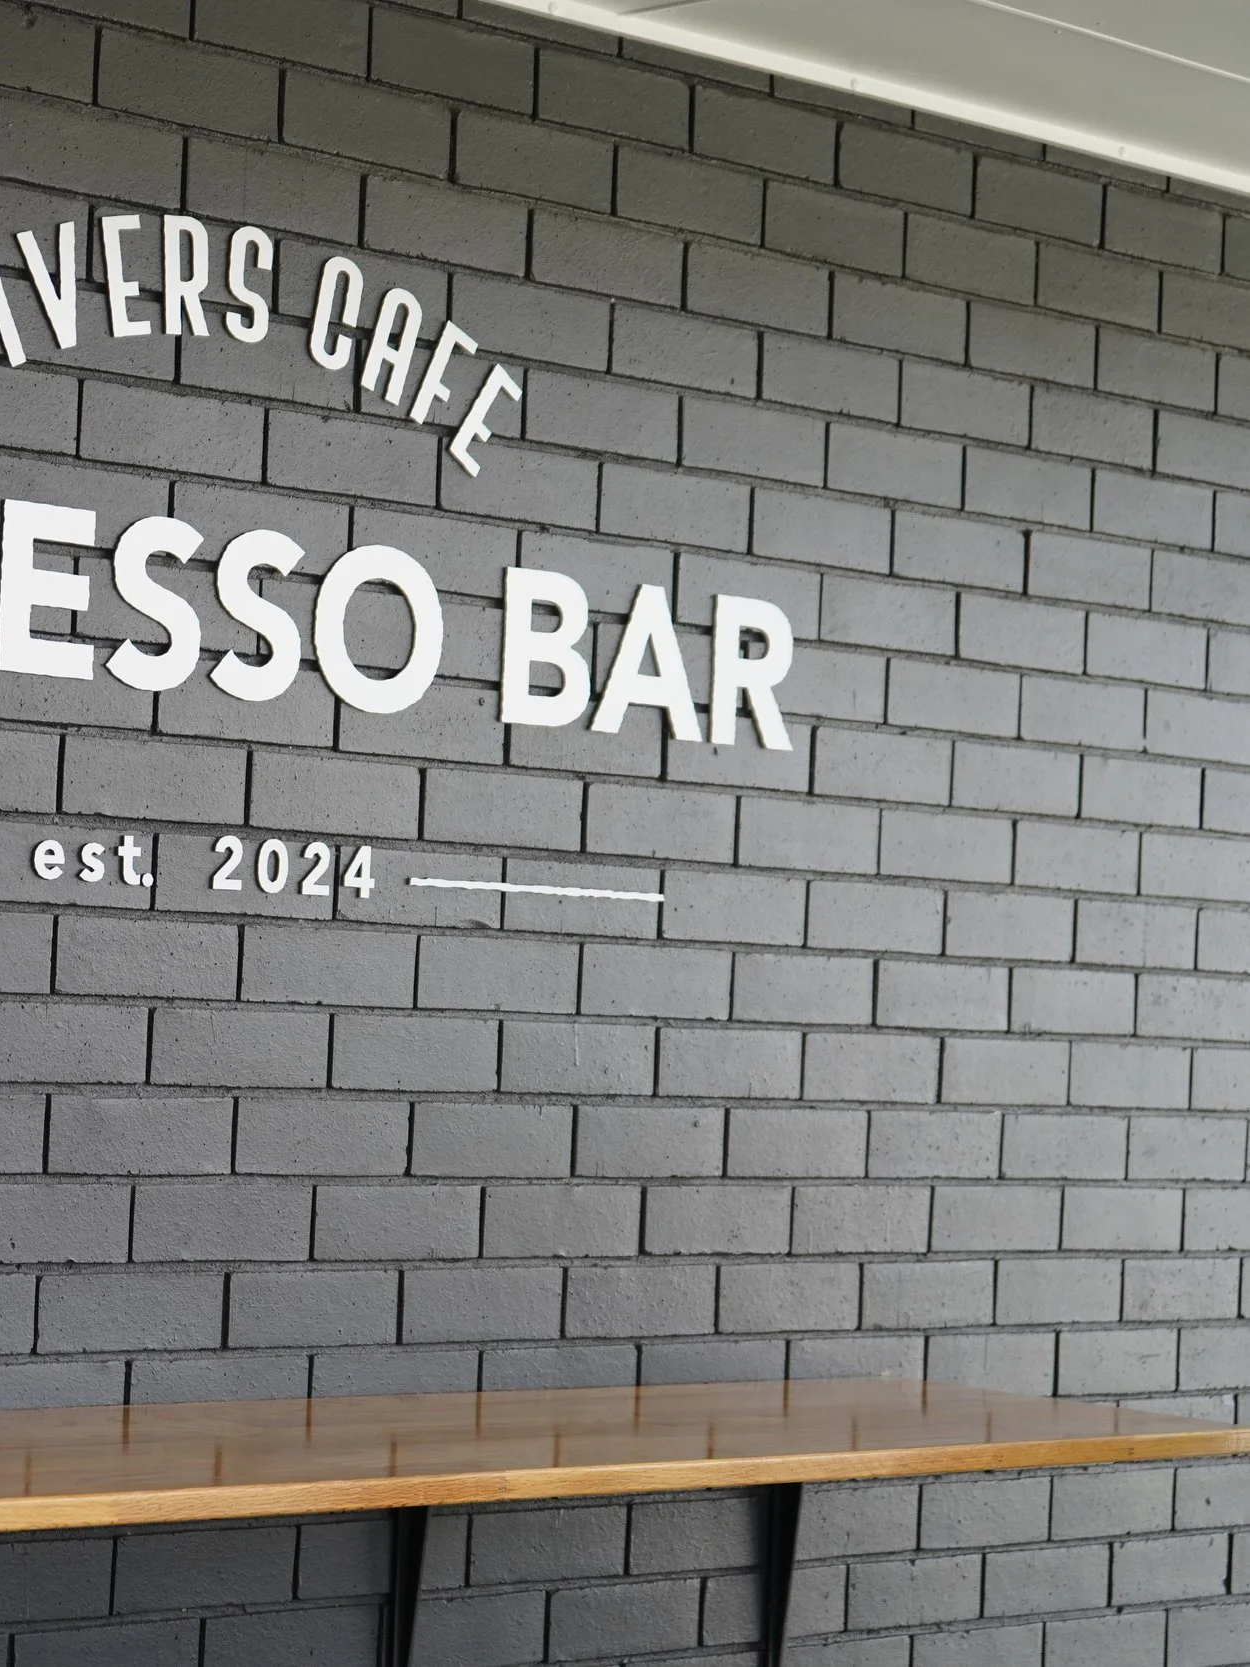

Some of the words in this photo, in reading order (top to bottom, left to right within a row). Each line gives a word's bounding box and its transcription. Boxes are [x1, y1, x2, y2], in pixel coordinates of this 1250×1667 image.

[309, 256, 523, 479] CAFE
[500, 565, 795, 756] BAR
[33, 834, 155, 889] est.
[212, 835, 377, 900] 2024
